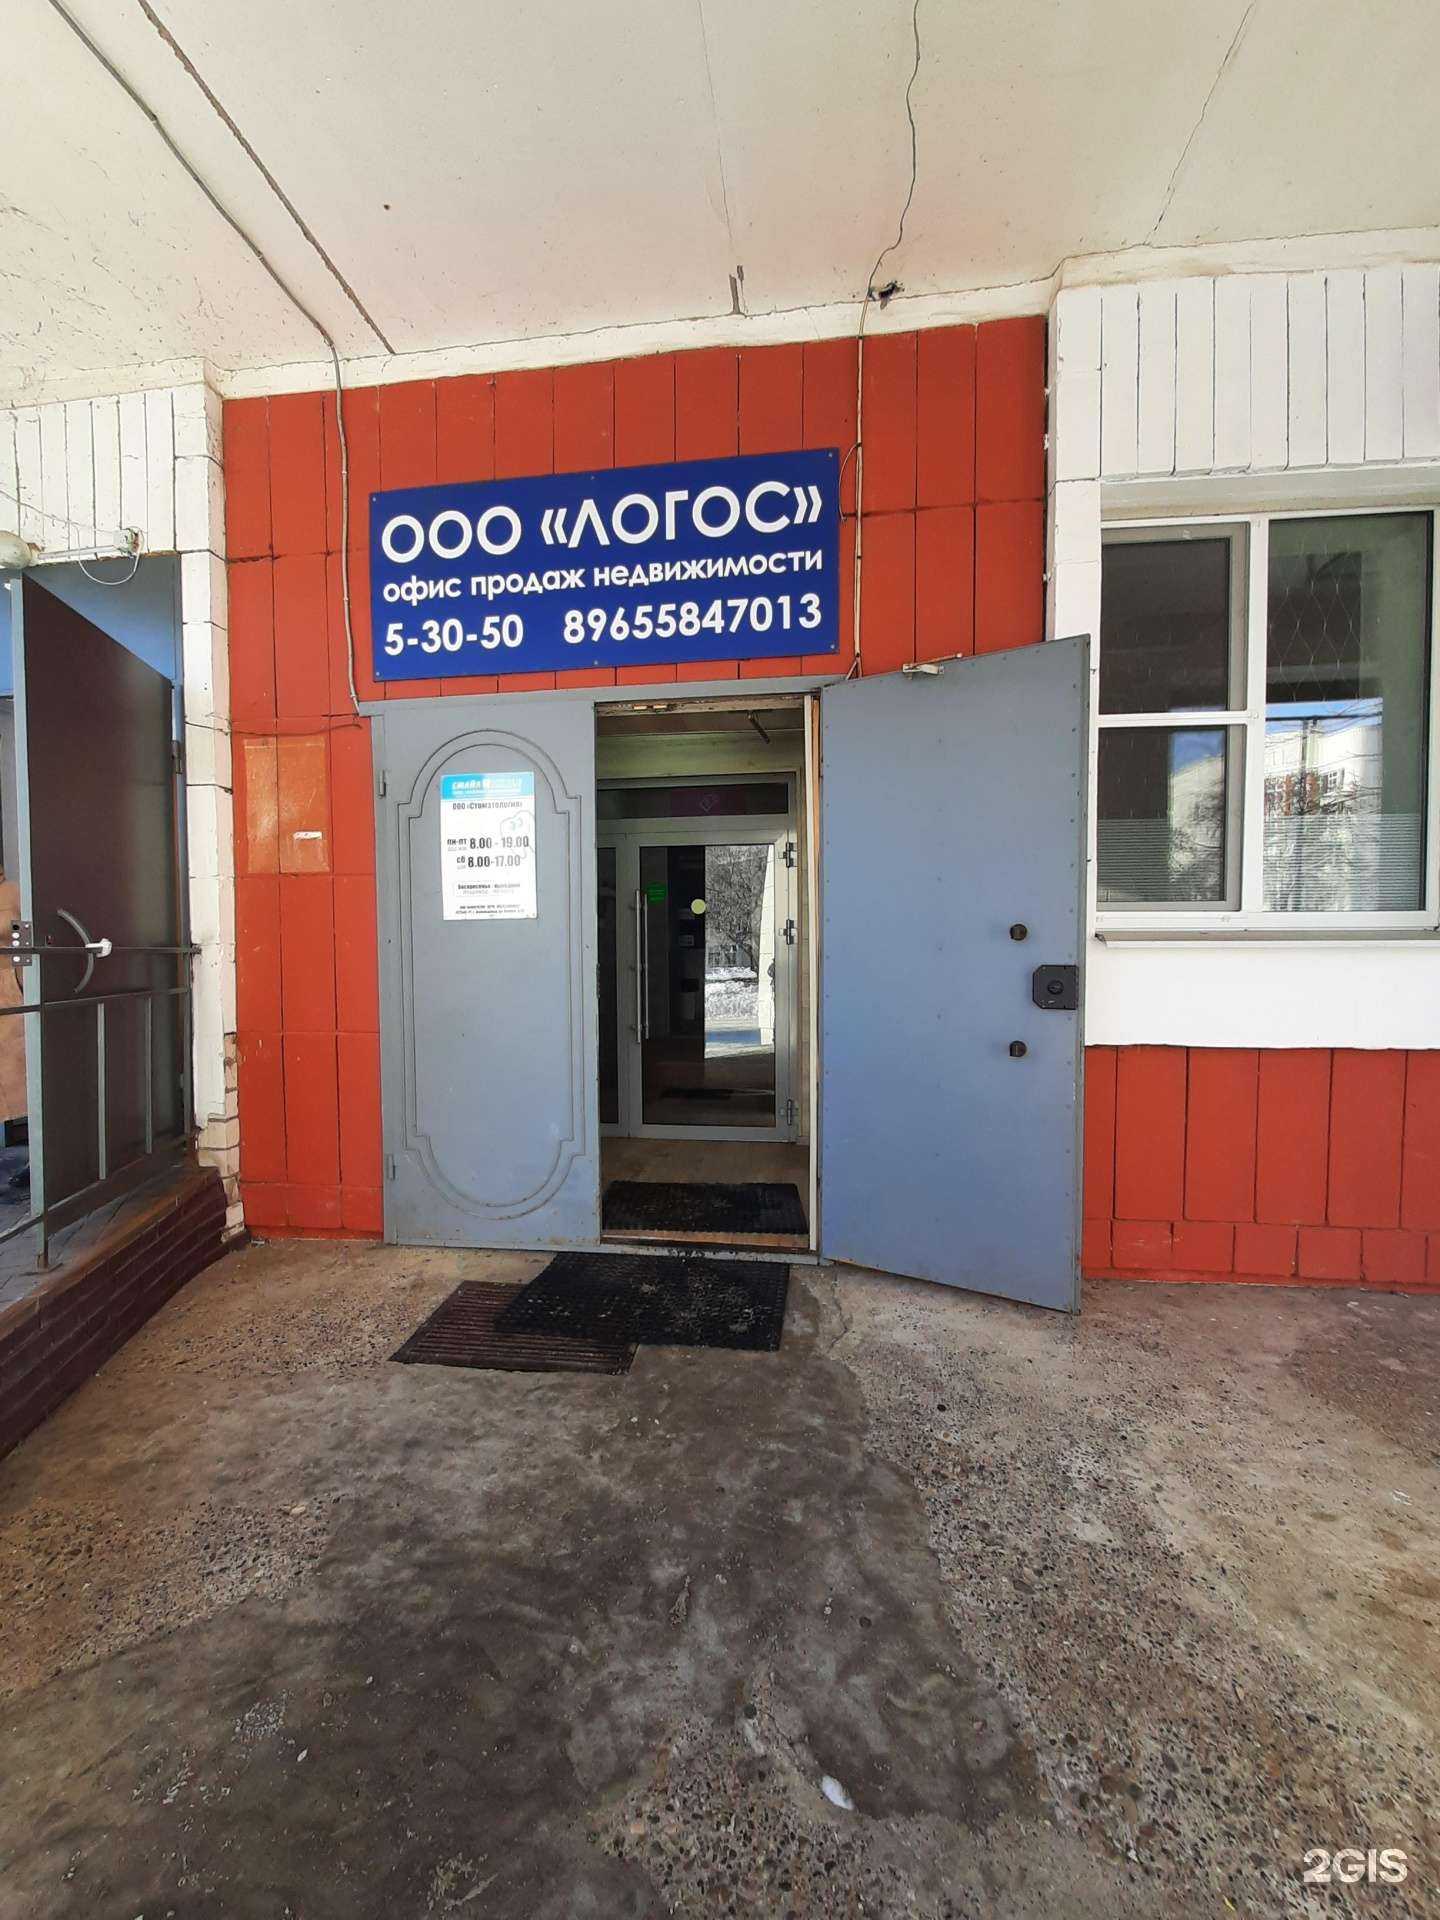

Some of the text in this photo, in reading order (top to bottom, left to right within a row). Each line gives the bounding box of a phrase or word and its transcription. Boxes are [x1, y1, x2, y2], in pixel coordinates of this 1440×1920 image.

[381, 480, 823, 564] ООО «ЛОГОС»
[383, 549, 823, 606] офис продаж недвижимости
[384, 592, 822, 656] 5-30-50 89655847013
[469, 837, 492, 849] 8.00
[501, 836, 529, 848] 19.00
